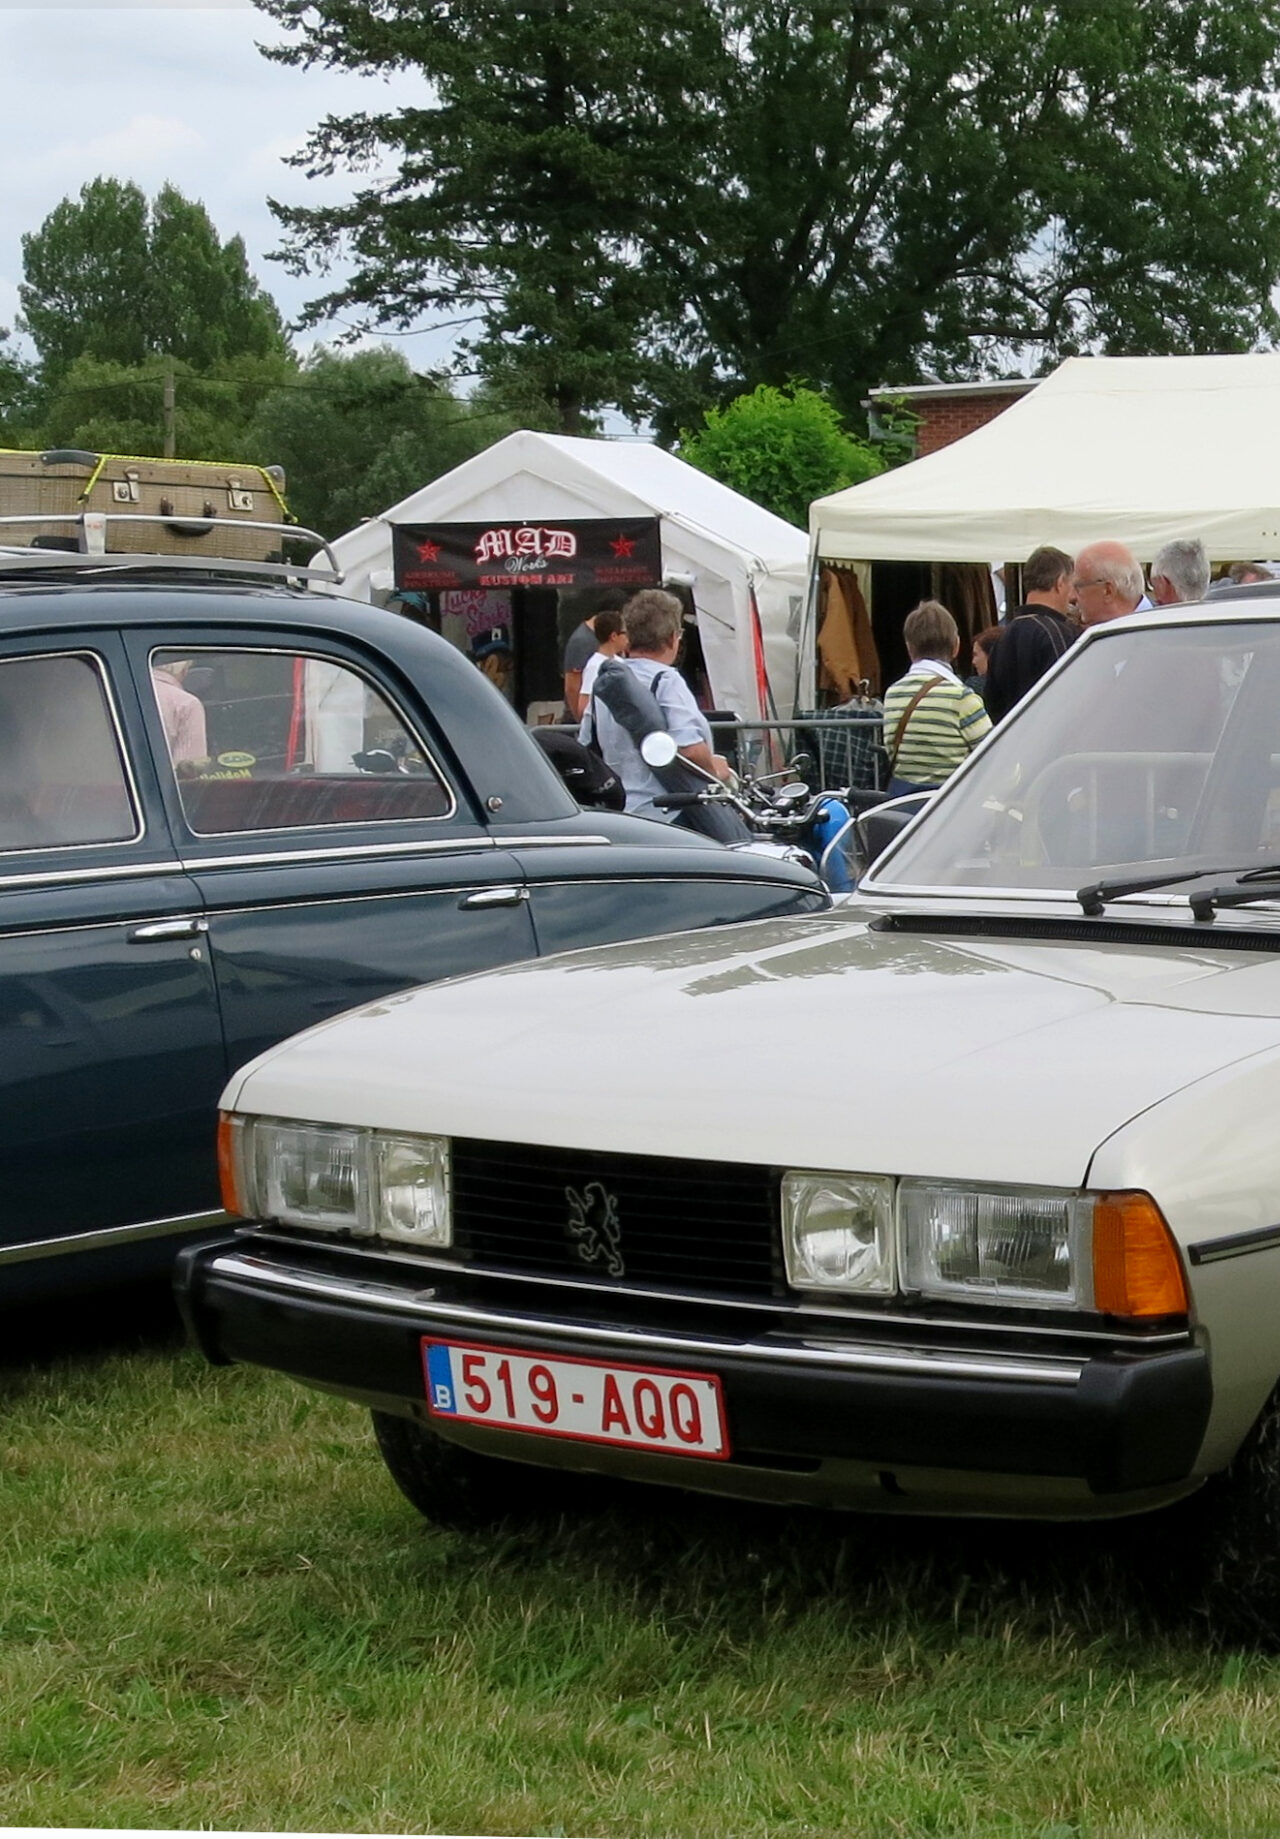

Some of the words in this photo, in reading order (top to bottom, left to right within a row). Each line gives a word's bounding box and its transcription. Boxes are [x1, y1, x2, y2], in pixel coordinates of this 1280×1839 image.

[475, 527, 577, 565] MAD
[504, 554, 549, 574] Works
[479, 574, 543, 586] KUSTOM
[546, 573, 574, 585] ART
[435, 1384, 452, 1409] B
[461, 1354, 704, 1445] 519-AQQ
